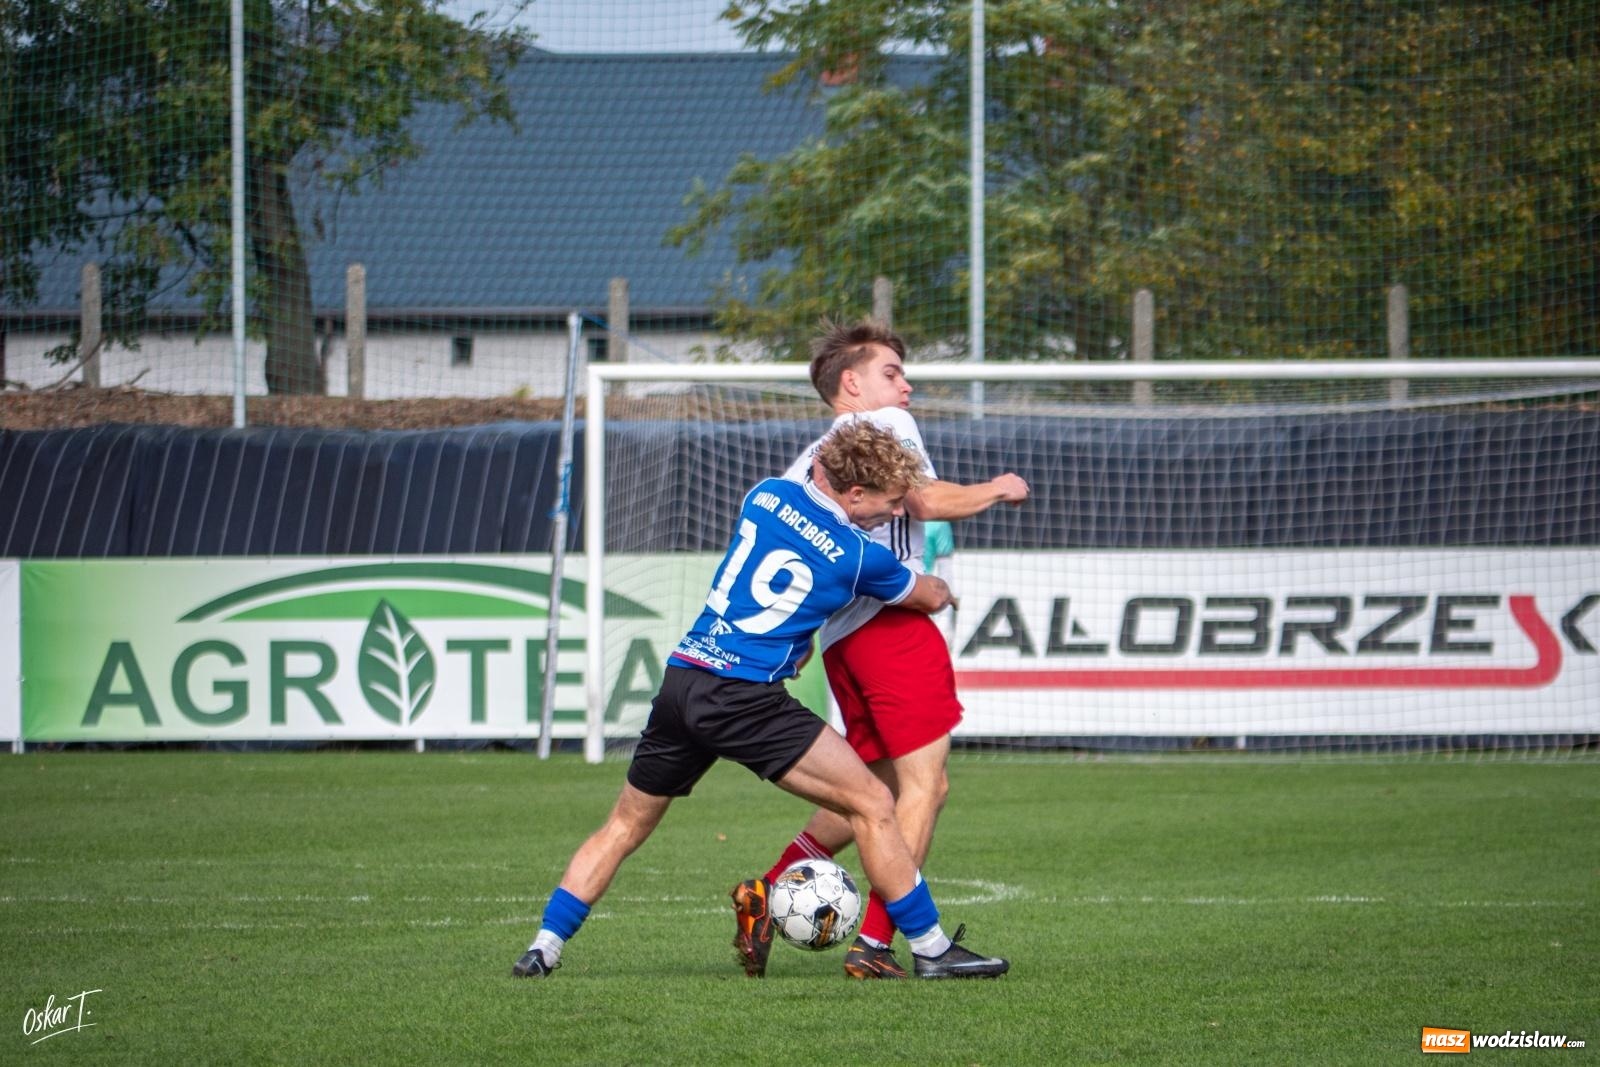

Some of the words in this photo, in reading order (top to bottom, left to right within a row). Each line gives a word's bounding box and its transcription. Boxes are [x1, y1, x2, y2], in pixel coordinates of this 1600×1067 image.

[752, 491, 781, 513] UNIA
[777, 503, 845, 564] RACIBÓRZ
[706, 518, 814, 634] 19
